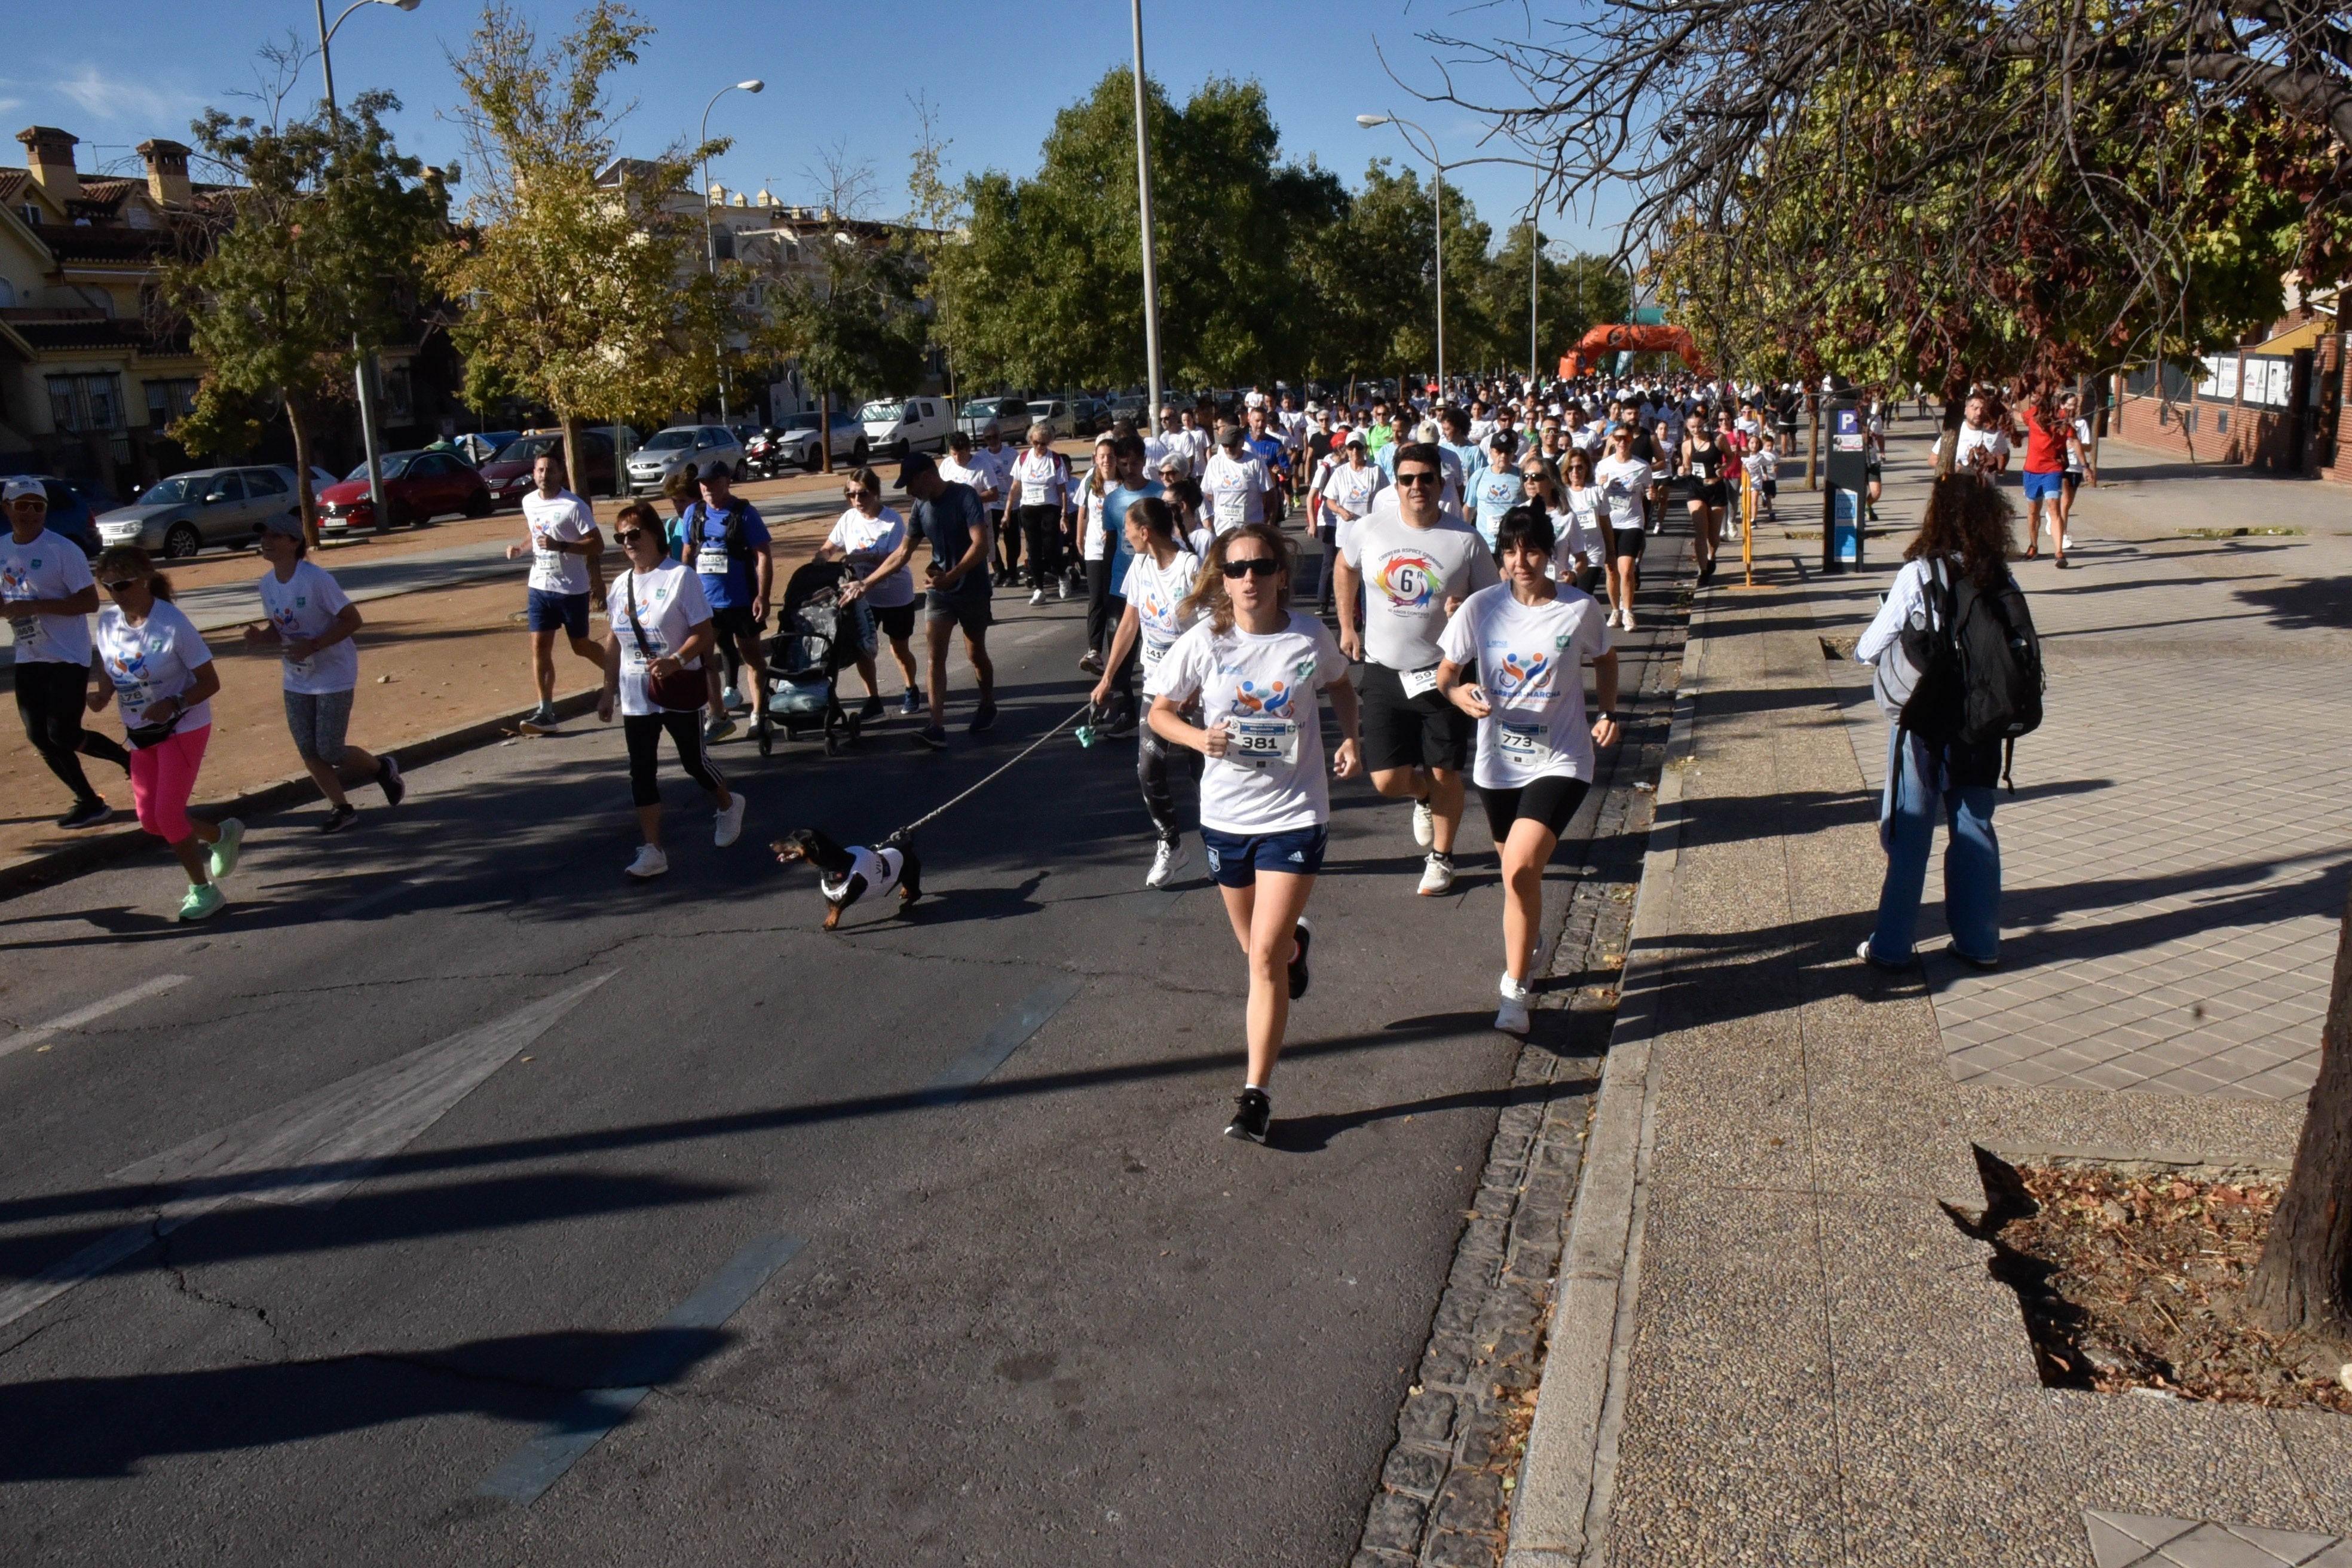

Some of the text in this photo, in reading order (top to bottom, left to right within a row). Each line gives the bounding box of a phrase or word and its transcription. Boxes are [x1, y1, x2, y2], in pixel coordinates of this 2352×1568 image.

[1842, 414, 1854, 430] P
[1242, 737, 1278, 749] 381
[1503, 733, 1532, 747] 773
